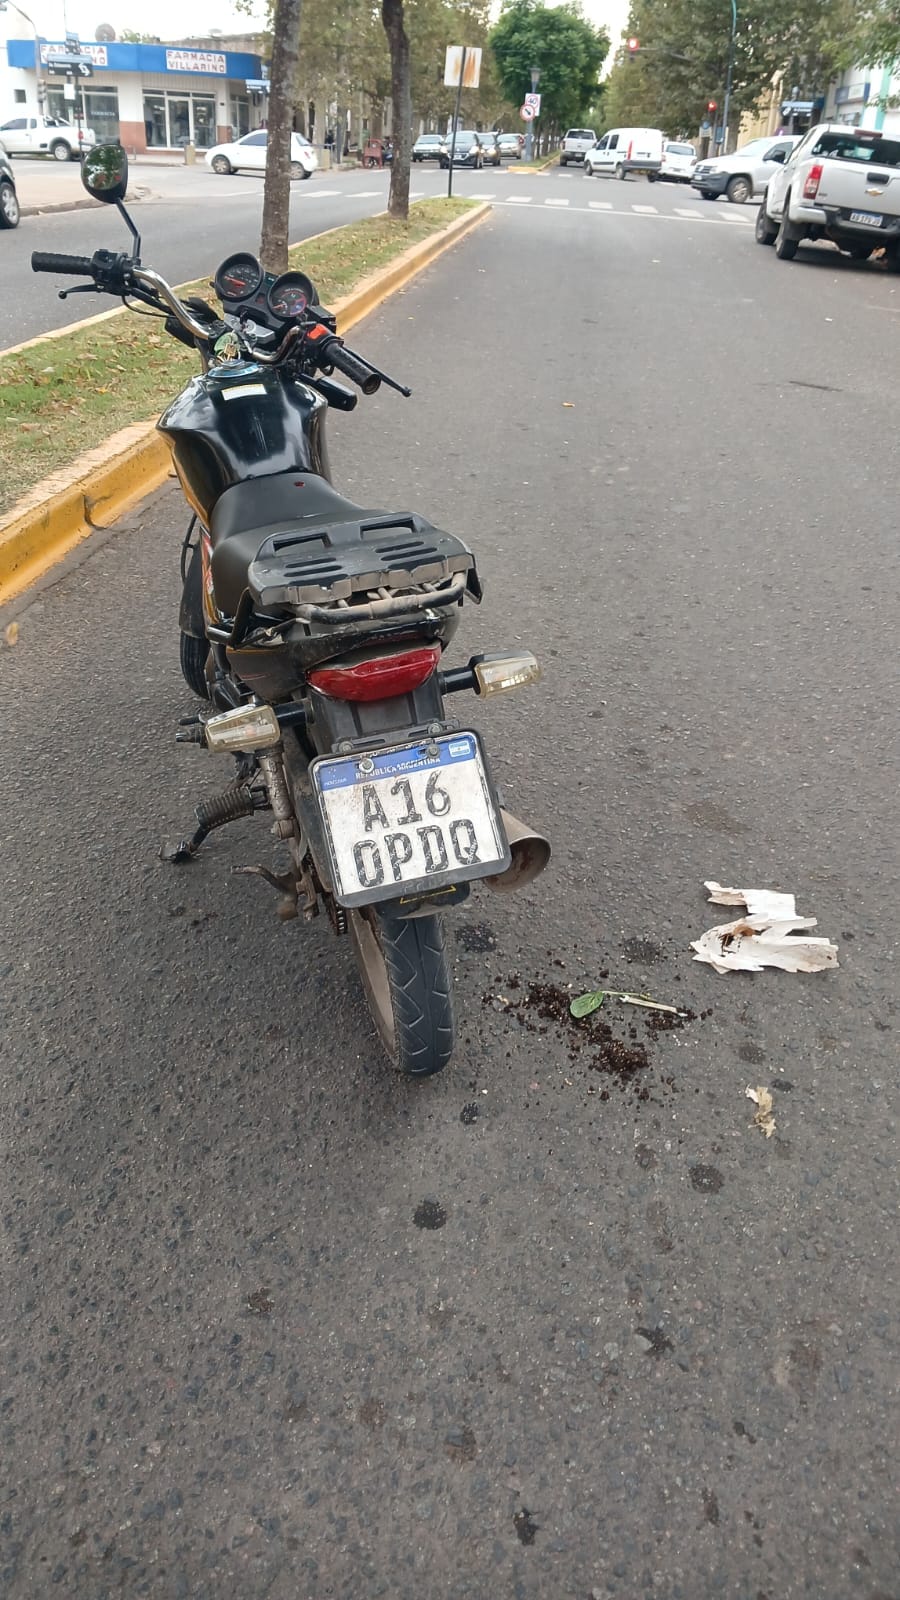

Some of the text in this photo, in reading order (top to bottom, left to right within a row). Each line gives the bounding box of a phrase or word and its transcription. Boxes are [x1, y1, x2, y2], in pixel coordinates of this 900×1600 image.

[41, 45, 105, 54] FARCIA
[167, 51, 225, 63] FARMACIA
[168, 61, 226, 73] VILLARINO
[362, 770, 452, 832] A16
